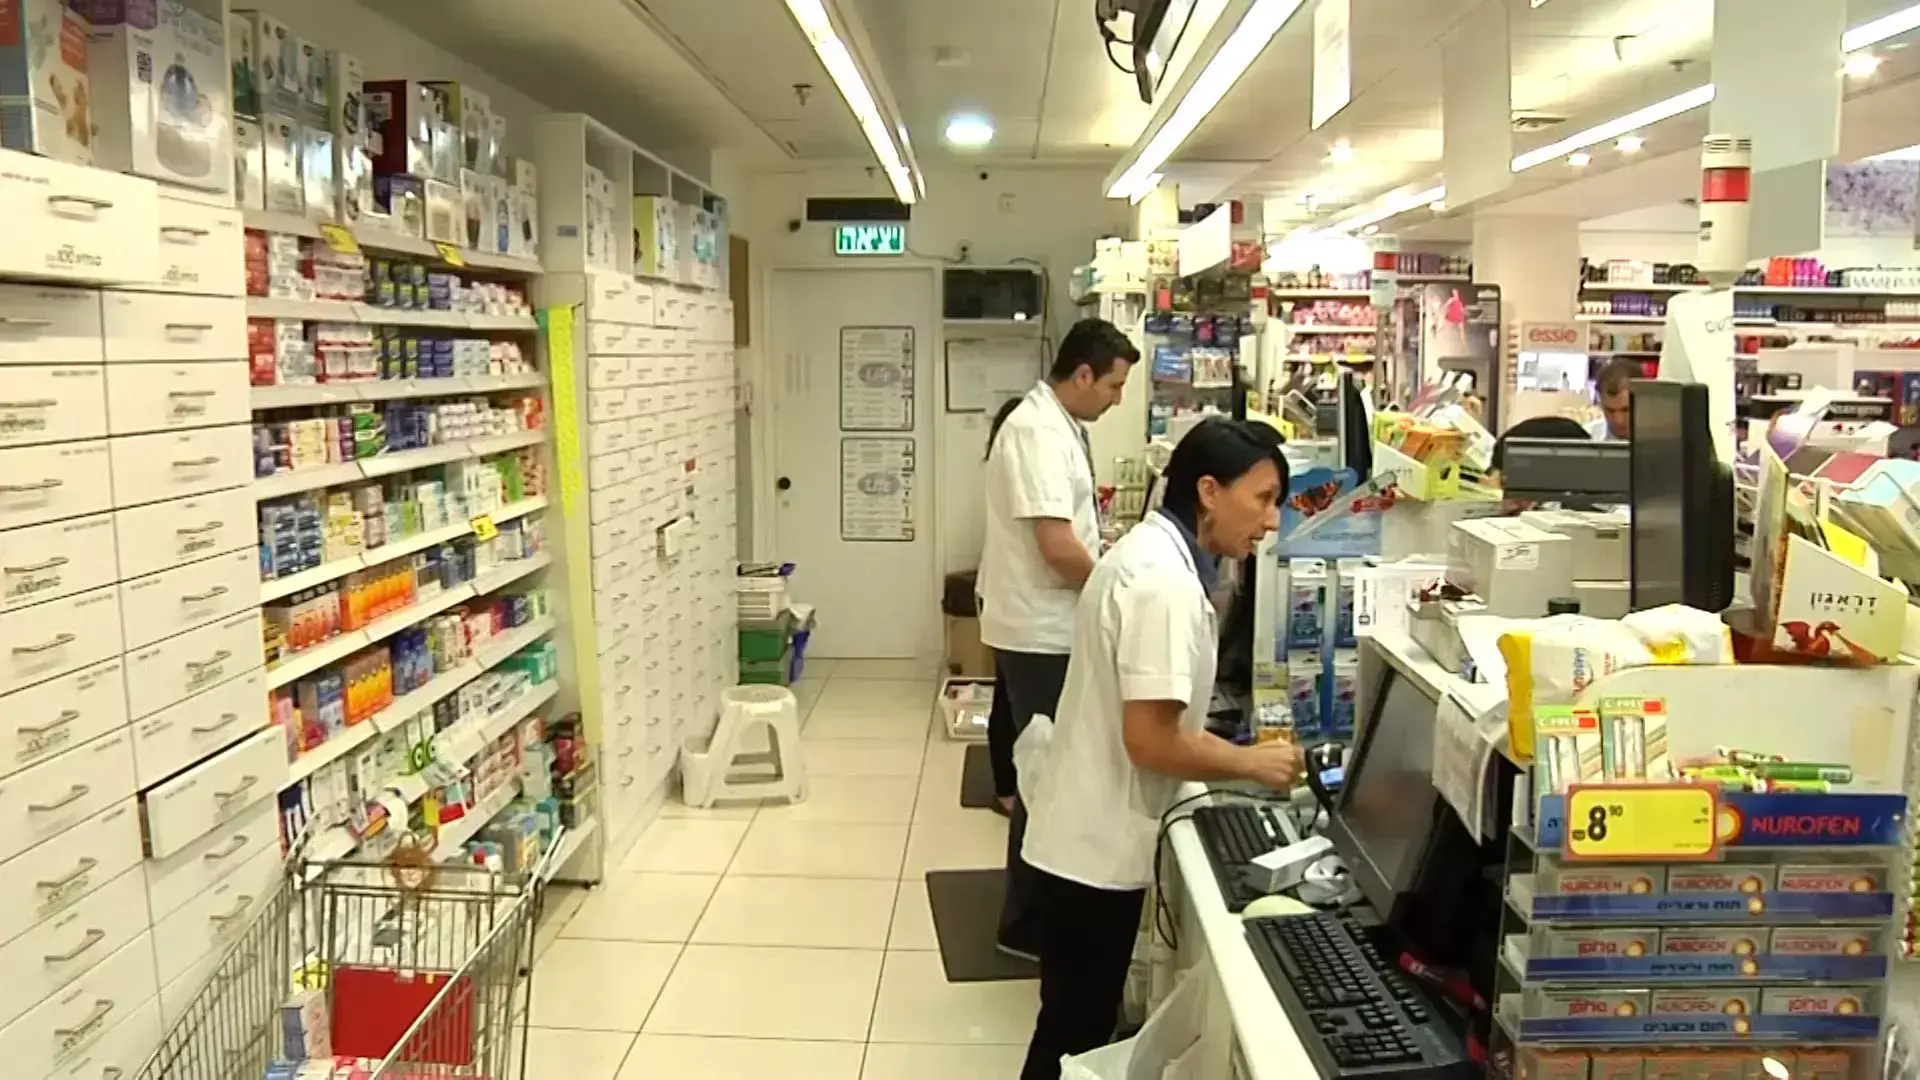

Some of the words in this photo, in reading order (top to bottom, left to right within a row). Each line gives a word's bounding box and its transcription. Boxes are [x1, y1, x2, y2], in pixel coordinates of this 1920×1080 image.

[838, 226, 901, 250] יציאה
[1529, 328, 1577, 343] essie
[1810, 592, 1878, 610] דראגון
[1588, 805, 1607, 841] 8
[1752, 815, 1861, 835] NUROFEN
